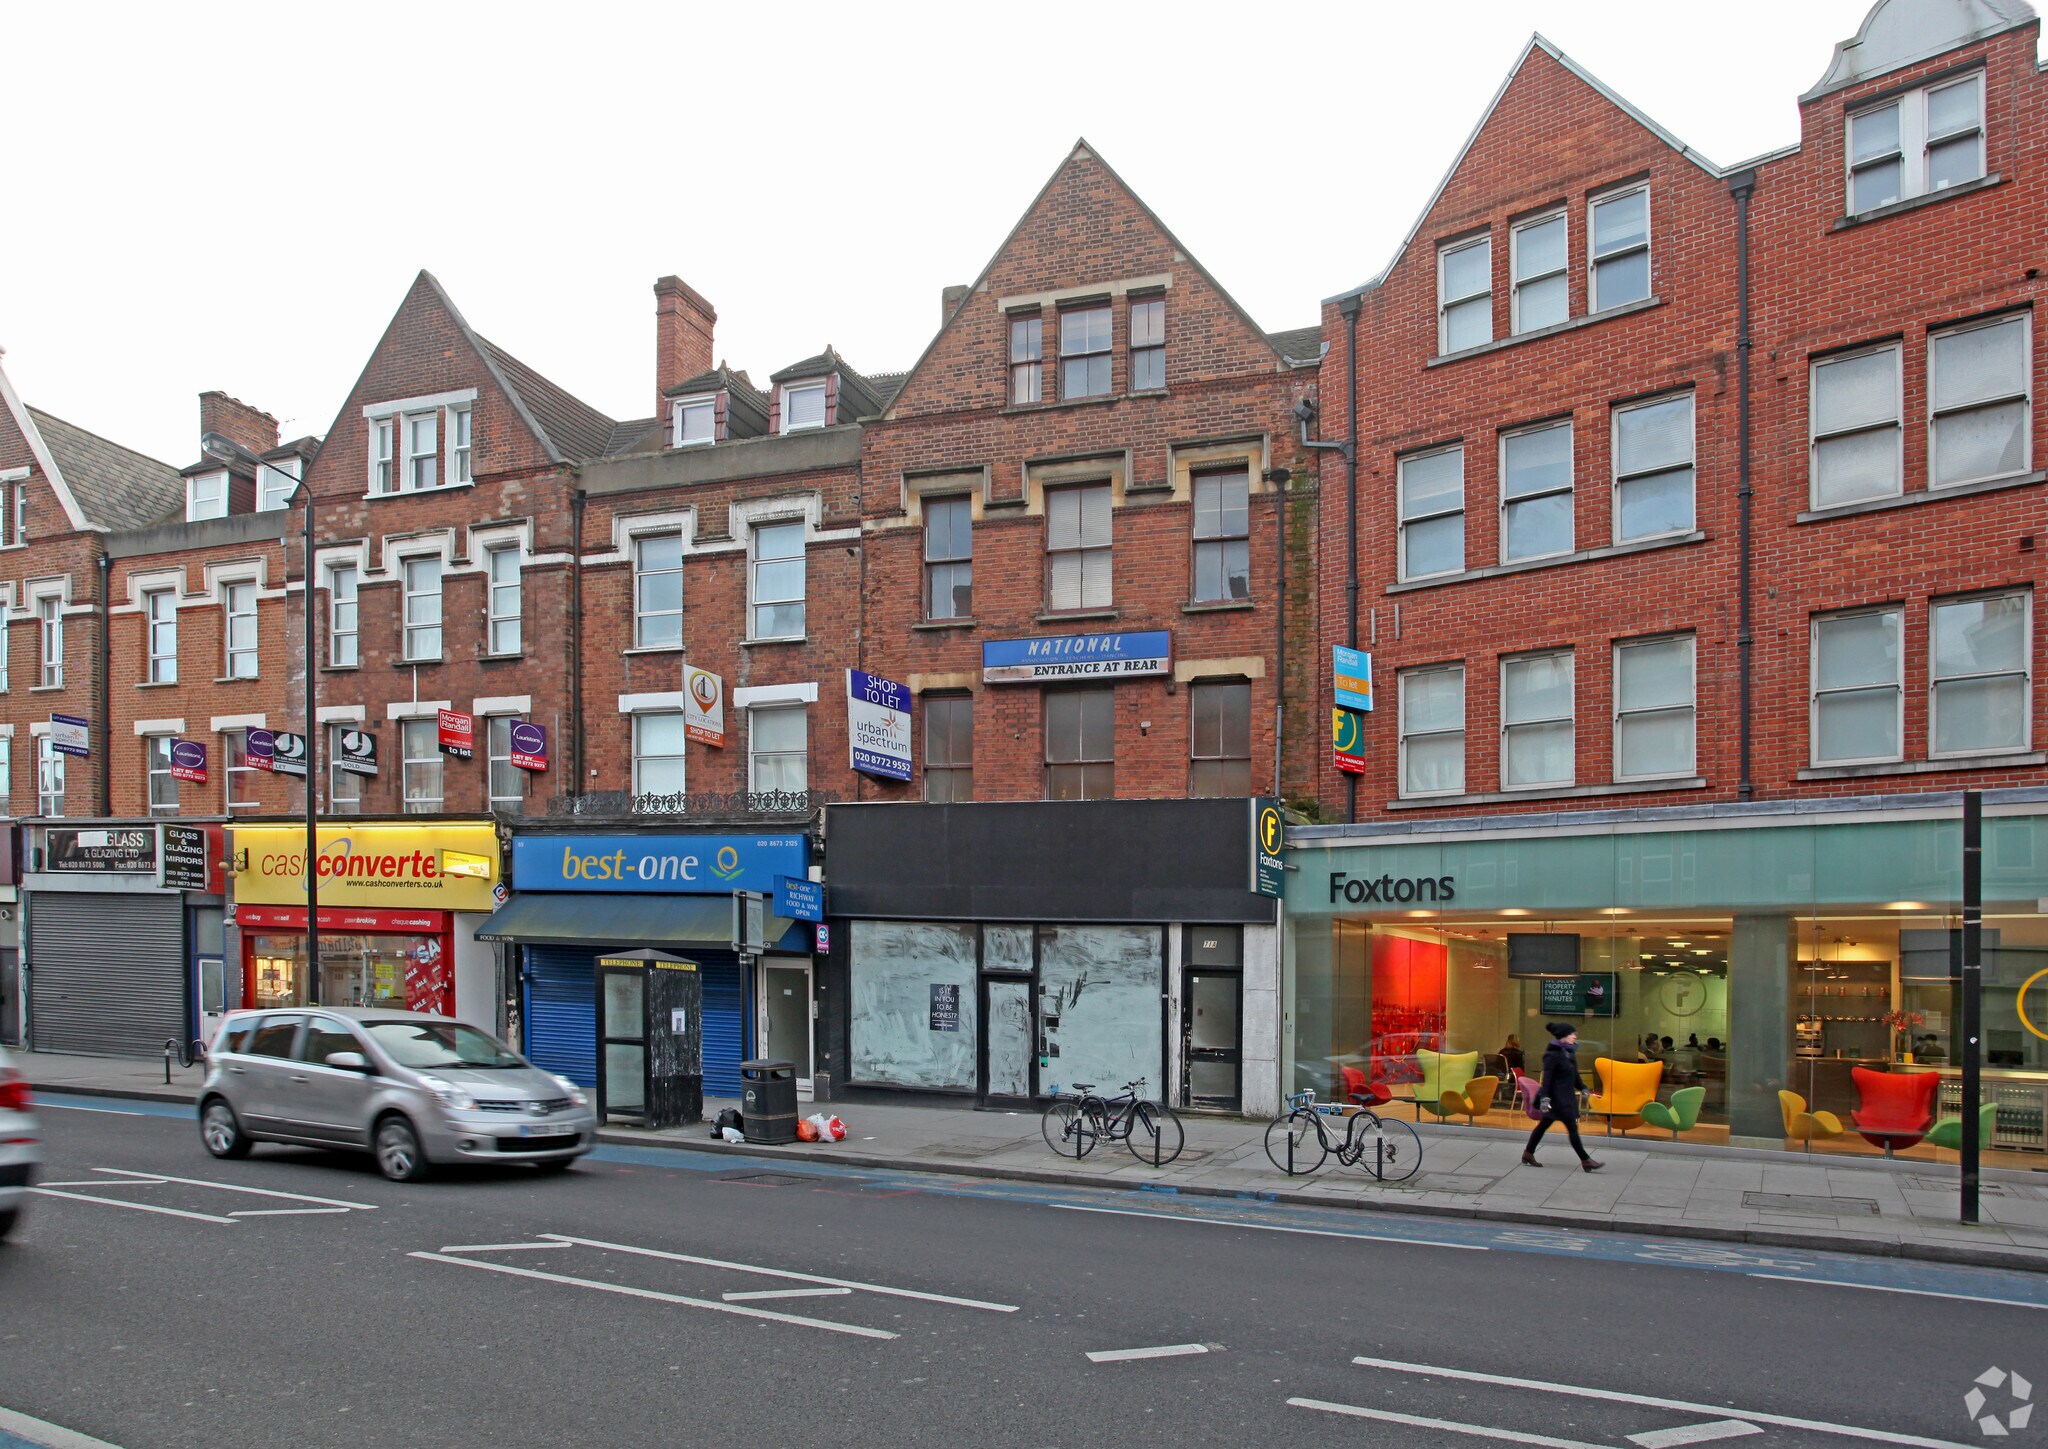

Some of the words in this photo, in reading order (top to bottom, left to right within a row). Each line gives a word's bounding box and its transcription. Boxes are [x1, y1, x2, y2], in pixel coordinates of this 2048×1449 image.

[1029, 636, 1121, 656] NATIONAL
[1034, 663, 1100, 676] ENTRANCE
[1103, 662, 1120, 672] AT
[1124, 660, 1158, 672] REAR
[867, 675, 898, 694] SHOP
[1338, 676, 1348, 687] To
[1349, 679, 1358, 690] let
[864, 687, 880, 703] TO
[882, 693, 901, 709] LET
[441, 713, 469, 725] Morgan
[441, 720, 469, 732] Randall
[689, 726, 704, 735] SHOP
[705, 730, 712, 738] TO
[856, 720, 889, 737] urban
[857, 732, 908, 753] spectrum
[449, 746, 458, 754] to
[459, 748, 472, 757] let
[854, 751, 870, 763] 020
[871, 755, 891, 767] 8772
[892, 759, 911, 772] 9552
[169, 830, 198, 840] GLASS
[1267, 815, 1277, 848] F
[106, 832, 144, 847] GLASS
[85, 849, 90, 858] &
[91, 849, 123, 858] GLAZING
[125, 849, 139, 858] LTD
[165, 843, 203, 855] GLAZING
[165, 854, 204, 866] MIRRORS
[316, 850, 464, 879] converte
[562, 846, 699, 880] best-one
[1260, 851, 1283, 870] Foxtons
[346, 880, 443, 888] www.cashconverters.co.uk
[786, 881, 811, 893] best-one
[1330, 871, 1455, 903] Foxtons
[786, 899, 800, 908] FOOD
[789, 891, 815, 902] RICHWAY
[795, 909, 811, 917] OPEN
[405, 967, 418, 981] SALE
[415, 978, 429, 989] SALE
[412, 998, 428, 1012] SALE
[931, 1012, 958, 1020] HONEST?
